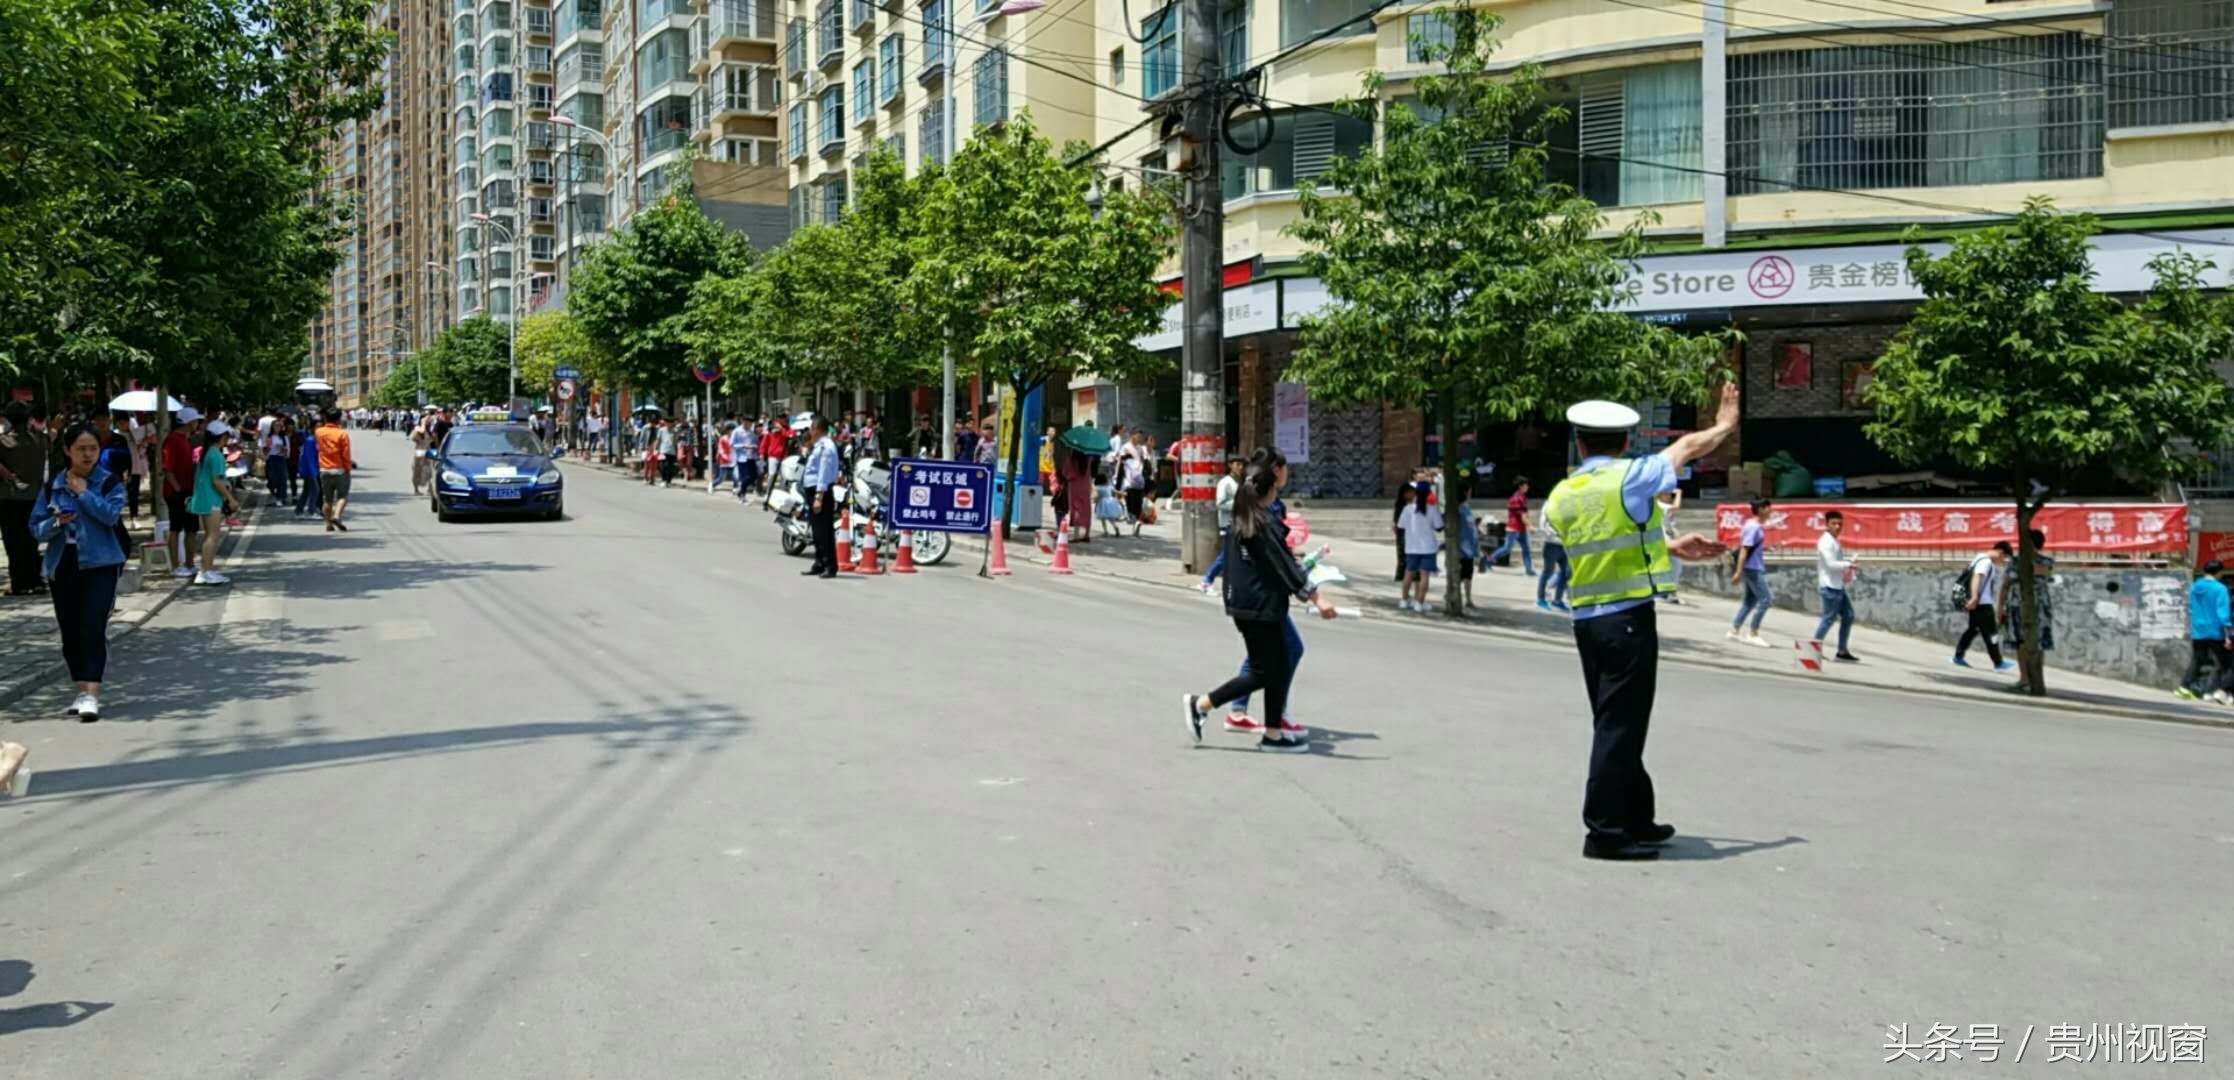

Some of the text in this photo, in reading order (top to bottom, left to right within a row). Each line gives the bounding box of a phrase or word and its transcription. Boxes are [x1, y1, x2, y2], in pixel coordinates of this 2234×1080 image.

[1652, 272, 1735, 296] Store
[1807, 261, 1912, 290] 贵金榜
[914, 470, 968, 486] 考试区域
